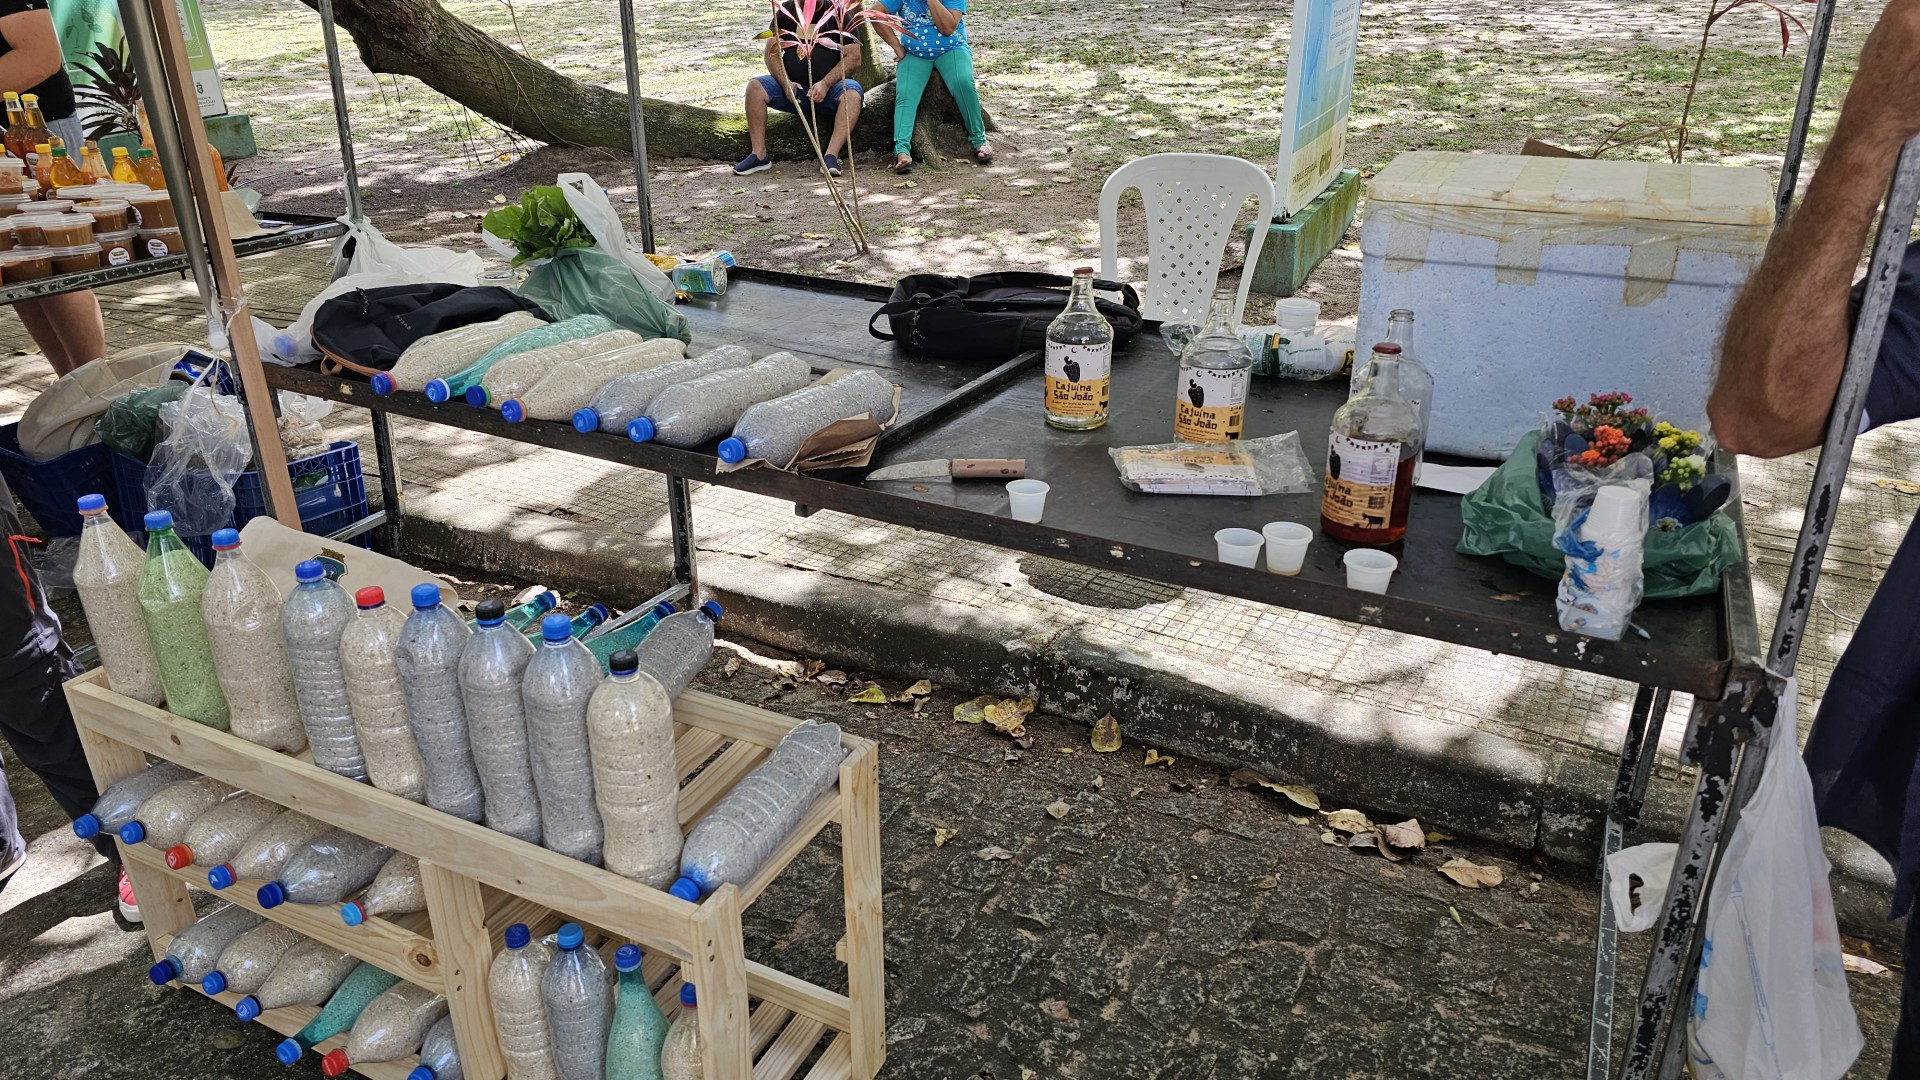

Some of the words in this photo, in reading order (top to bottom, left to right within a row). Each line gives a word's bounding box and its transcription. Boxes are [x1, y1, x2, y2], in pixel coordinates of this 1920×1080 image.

[1055, 381, 1092, 392] Cajuína
[1053, 390, 1069, 400] São
[1071, 391, 1094, 401] João
[1180, 404, 1216, 419] Cajuína
[1178, 413, 1192, 425] São
[1193, 418, 1217, 430] João
